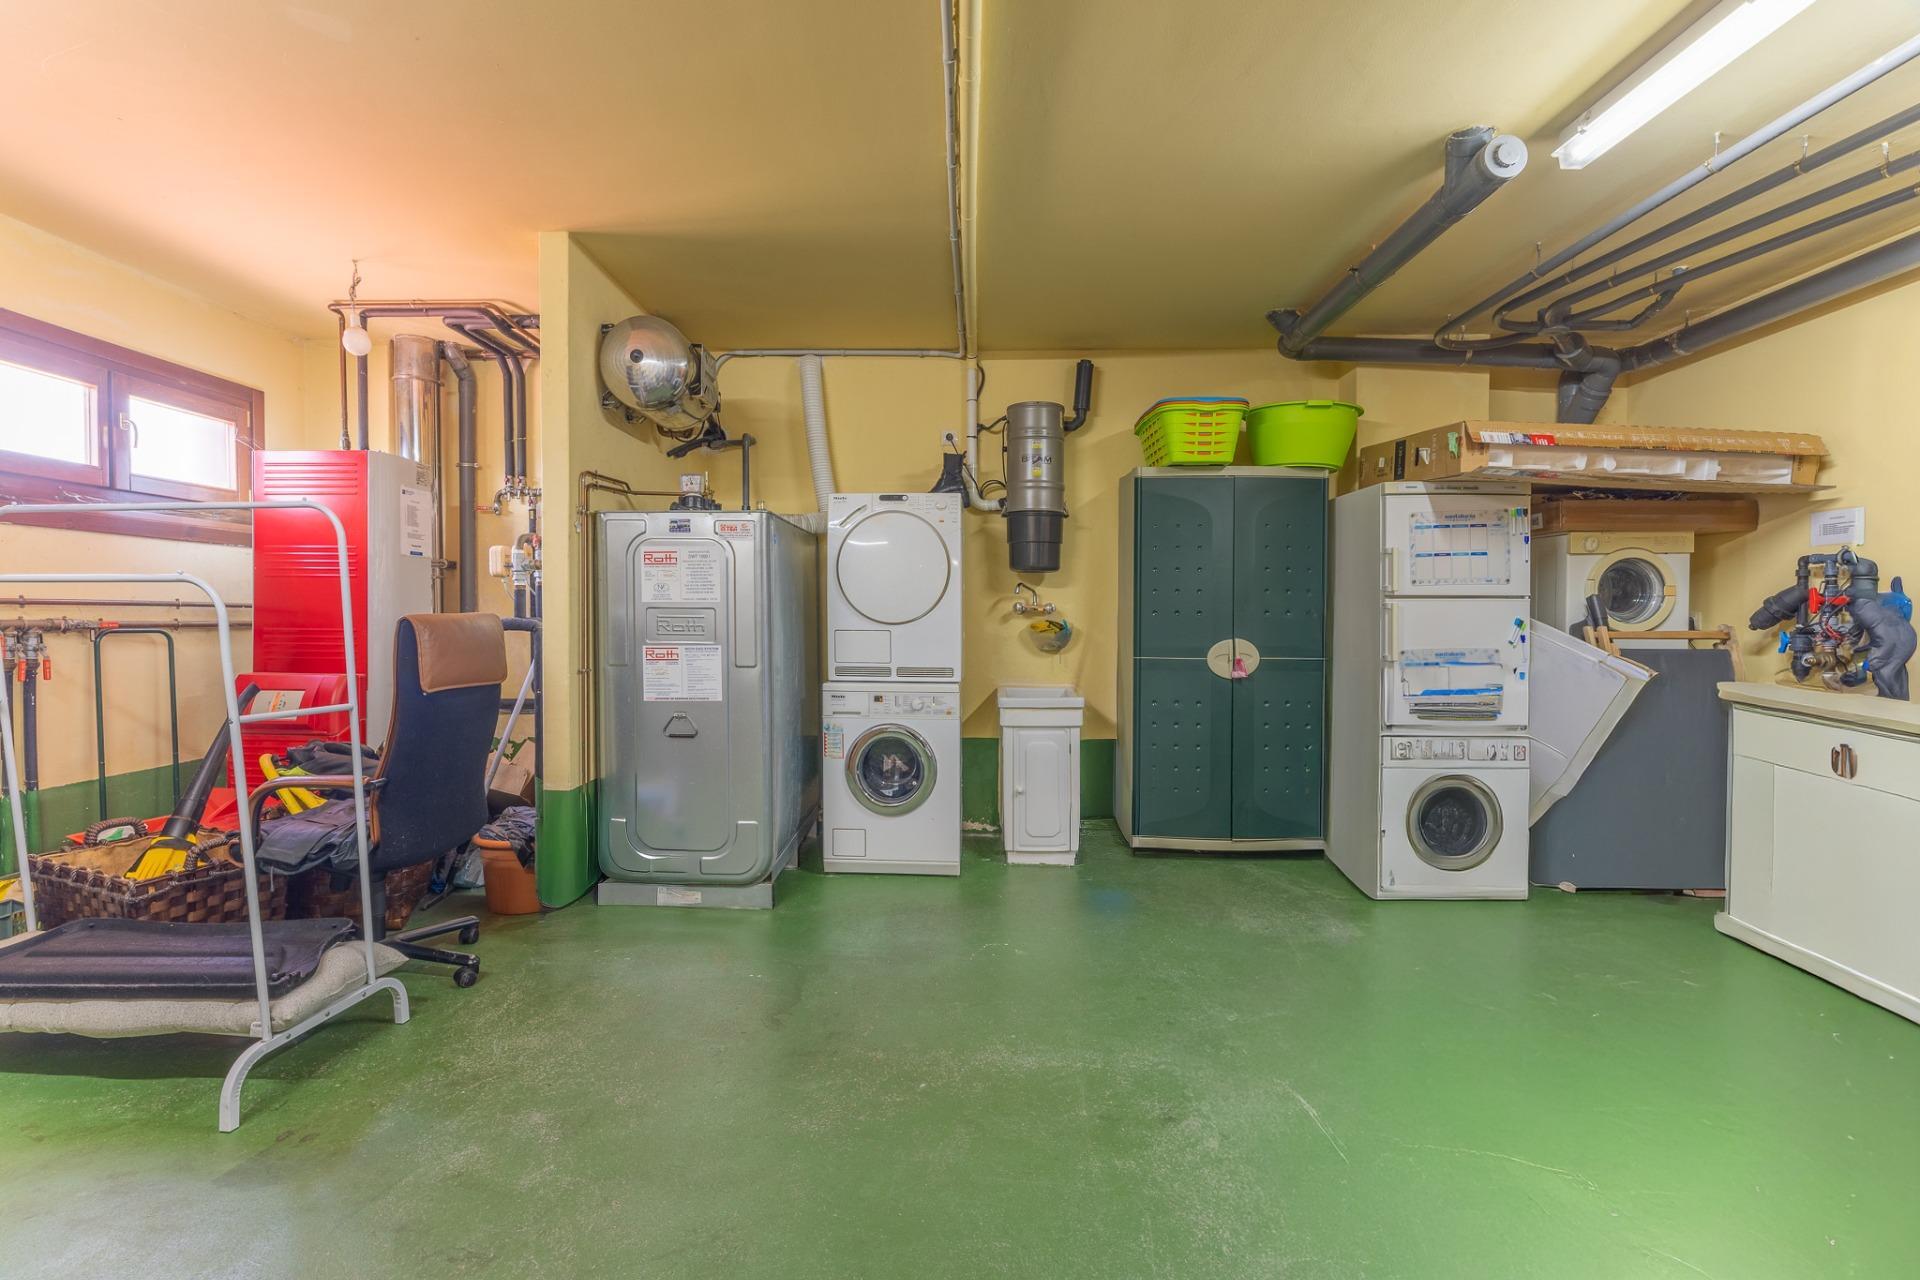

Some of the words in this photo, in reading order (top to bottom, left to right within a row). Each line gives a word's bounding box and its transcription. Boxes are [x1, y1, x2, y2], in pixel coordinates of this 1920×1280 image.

[644, 553, 677, 563] Roth
[657, 619, 705, 632] Roth
[645, 649, 679, 659] Roth
